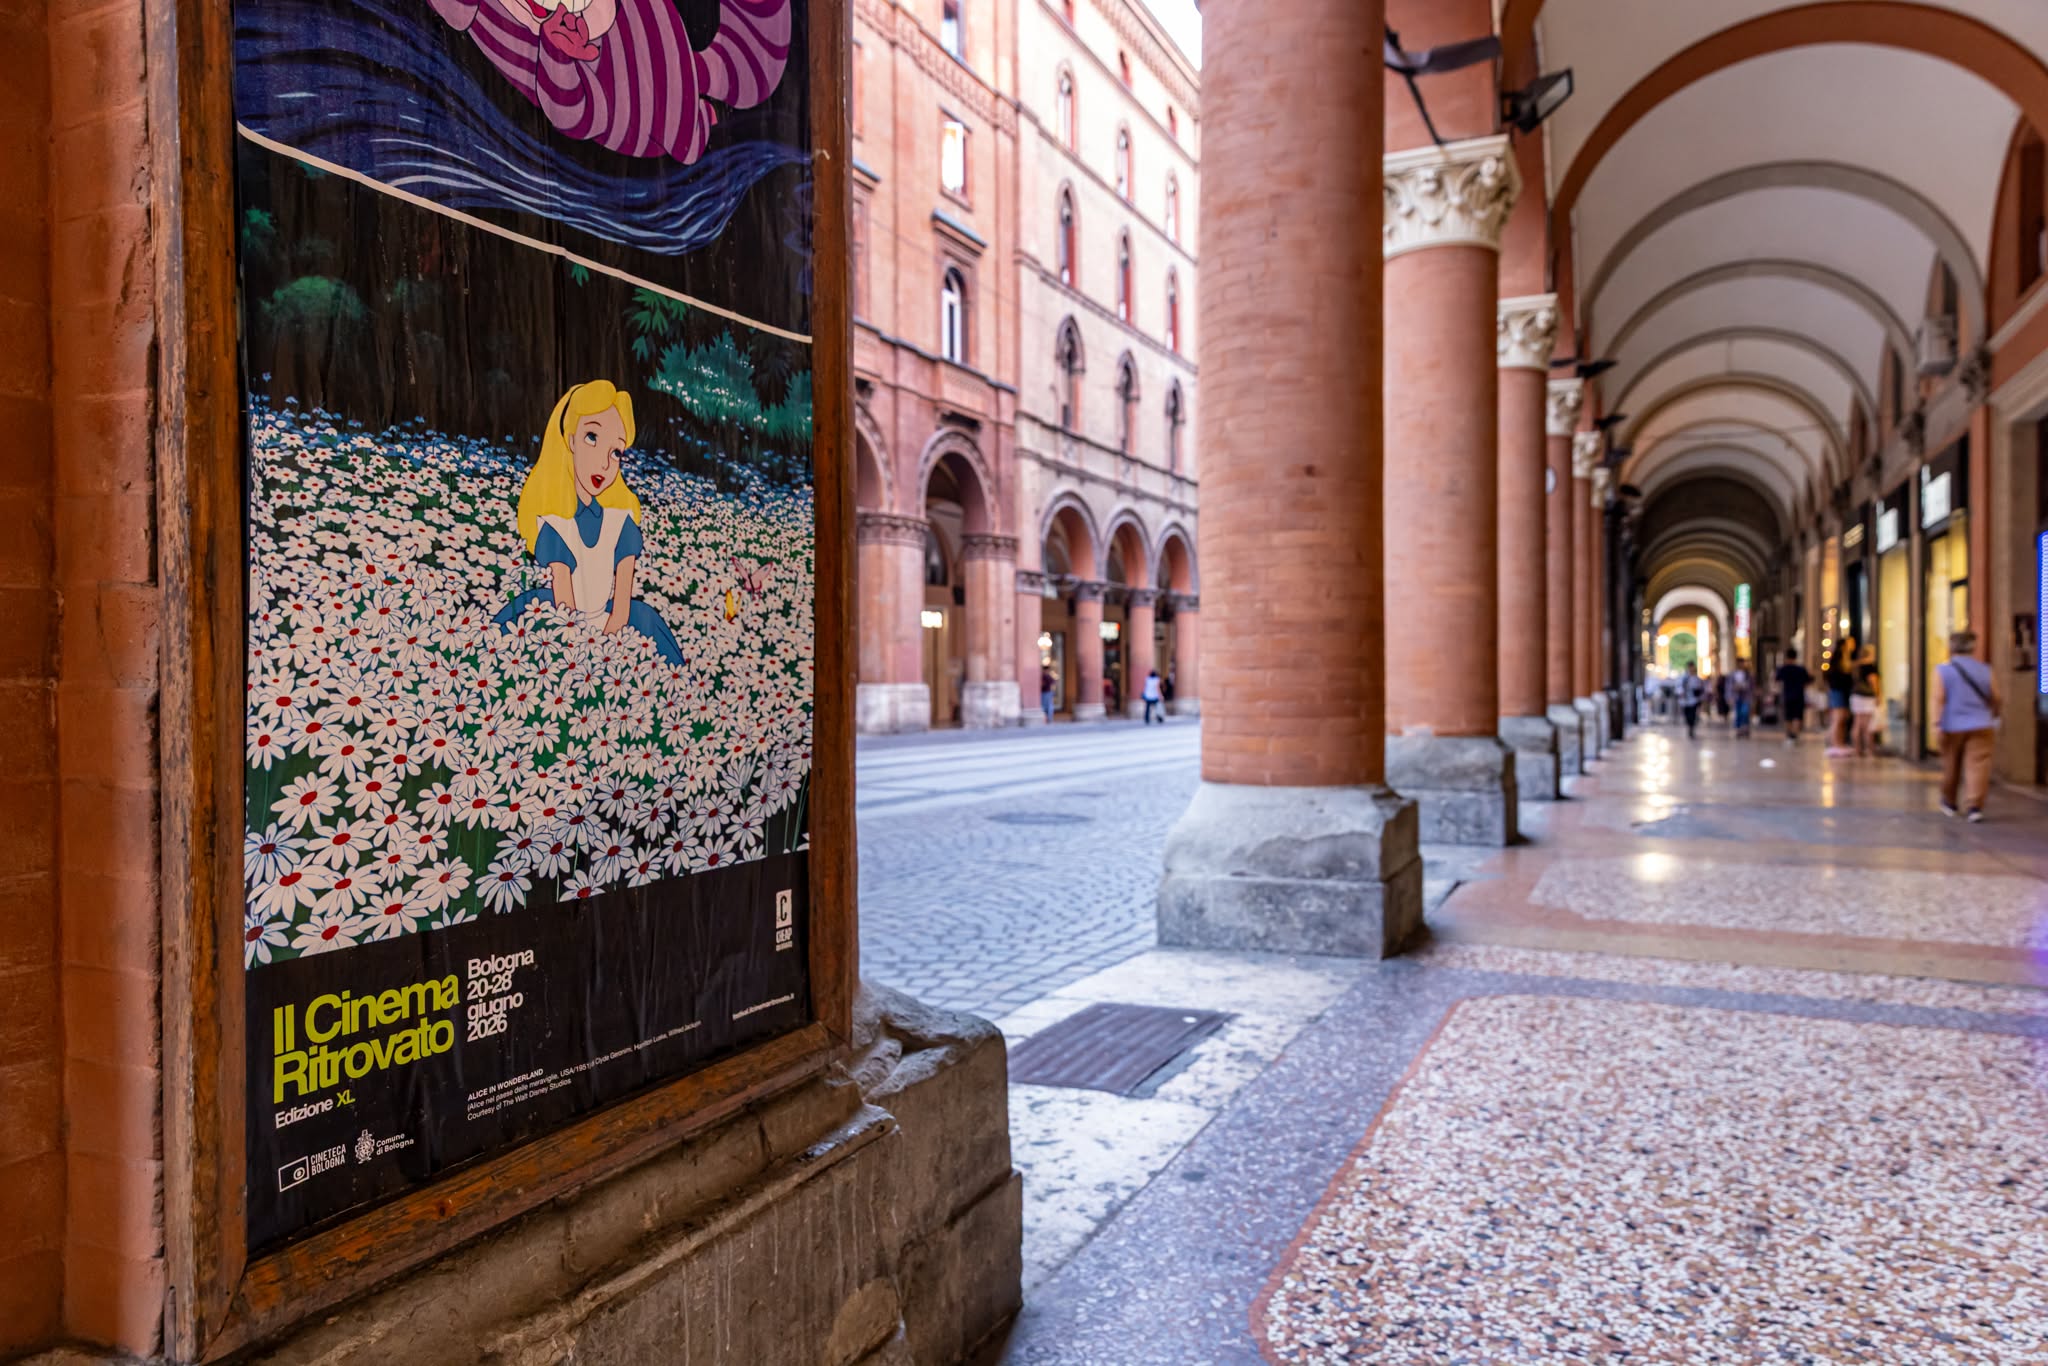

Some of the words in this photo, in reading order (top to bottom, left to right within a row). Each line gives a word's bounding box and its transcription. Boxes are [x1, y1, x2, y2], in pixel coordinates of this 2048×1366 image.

[468, 949, 534, 979] Bologna
[467, 971, 512, 1000] 20-28
[274, 1004, 295, 1056] Il
[305, 974, 460, 1043] Cinema
[467, 992, 523, 1022] giugno
[467, 1012, 507, 1042] 2026
[274, 1017, 455, 1104] Ritrovato
[468, 1088, 488, 1102] ALICE
[489, 1085, 496, 1094] IN
[497, 1068, 544, 1090] WONDERLAND
[275, 1098, 334, 1129] Edizione
[336, 1089, 356, 1108] XL
[467, 1107, 495, 1121] Courtesy
[496, 1101, 502, 1111] of
[502, 1099, 514, 1108] The
[310, 1143, 347, 1166] CINETECA
[376, 1133, 405, 1148] Comune
[376, 1148, 384, 1156] di
[384, 1139, 415, 1153] Bologna
[311, 1154, 346, 1176] BOLOGNA
